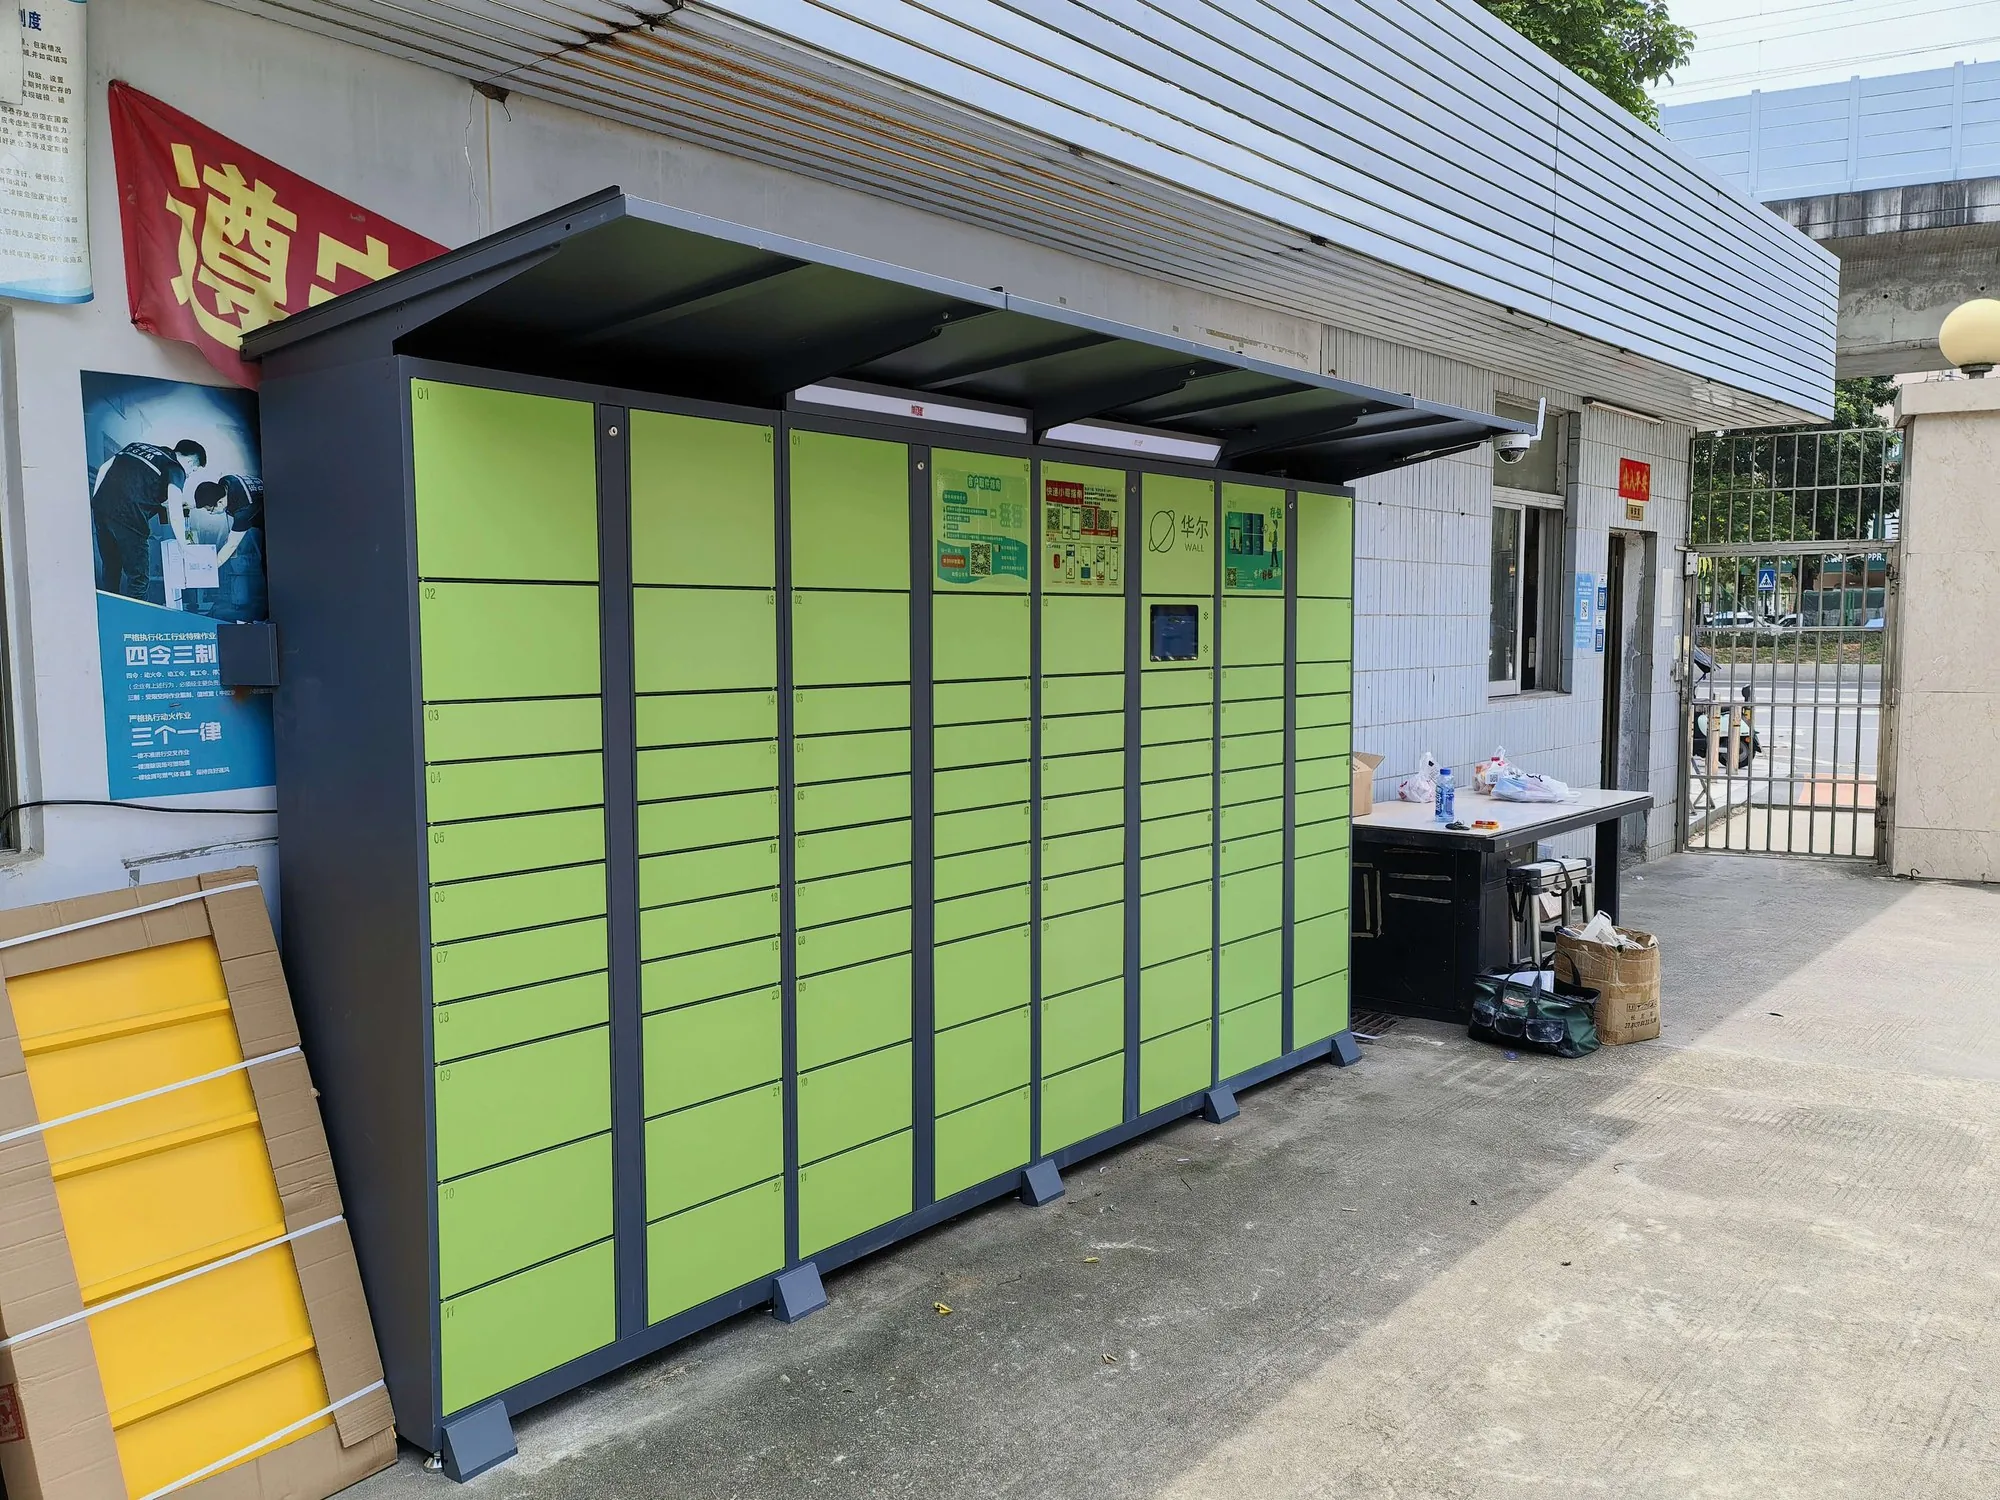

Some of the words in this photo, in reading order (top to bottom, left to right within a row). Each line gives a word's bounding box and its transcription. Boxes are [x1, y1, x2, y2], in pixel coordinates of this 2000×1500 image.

[417, 387, 430, 400] 01
[764, 433, 772, 443] 12
[792, 435, 801, 445] 01
[1181, 514, 1209, 539] 华尔
[1184, 542, 1205, 553] WALL
[424, 588, 436, 600] 02
[794, 595, 803, 605] 02
[123, 632, 217, 642] 严格执行化工行业特殊作业
[125, 643, 217, 666] 四令三制
[767, 695, 775, 705] 14
[128, 711, 191, 723] 严格执行动火作业
[428, 709, 440, 721] 03
[131, 721, 222, 747] 三个一律
[430, 772, 442, 784] 04
[433, 832, 445, 844] 05
[769, 843, 777, 854] 17
[434, 891, 445, 903] 06
[436, 951, 448, 963] 07
[440, 1069, 451, 1082] 09
[800, 1173, 807, 1183] 11
[444, 1187, 455, 1200] 10
[445, 1305, 454, 1319] 11
